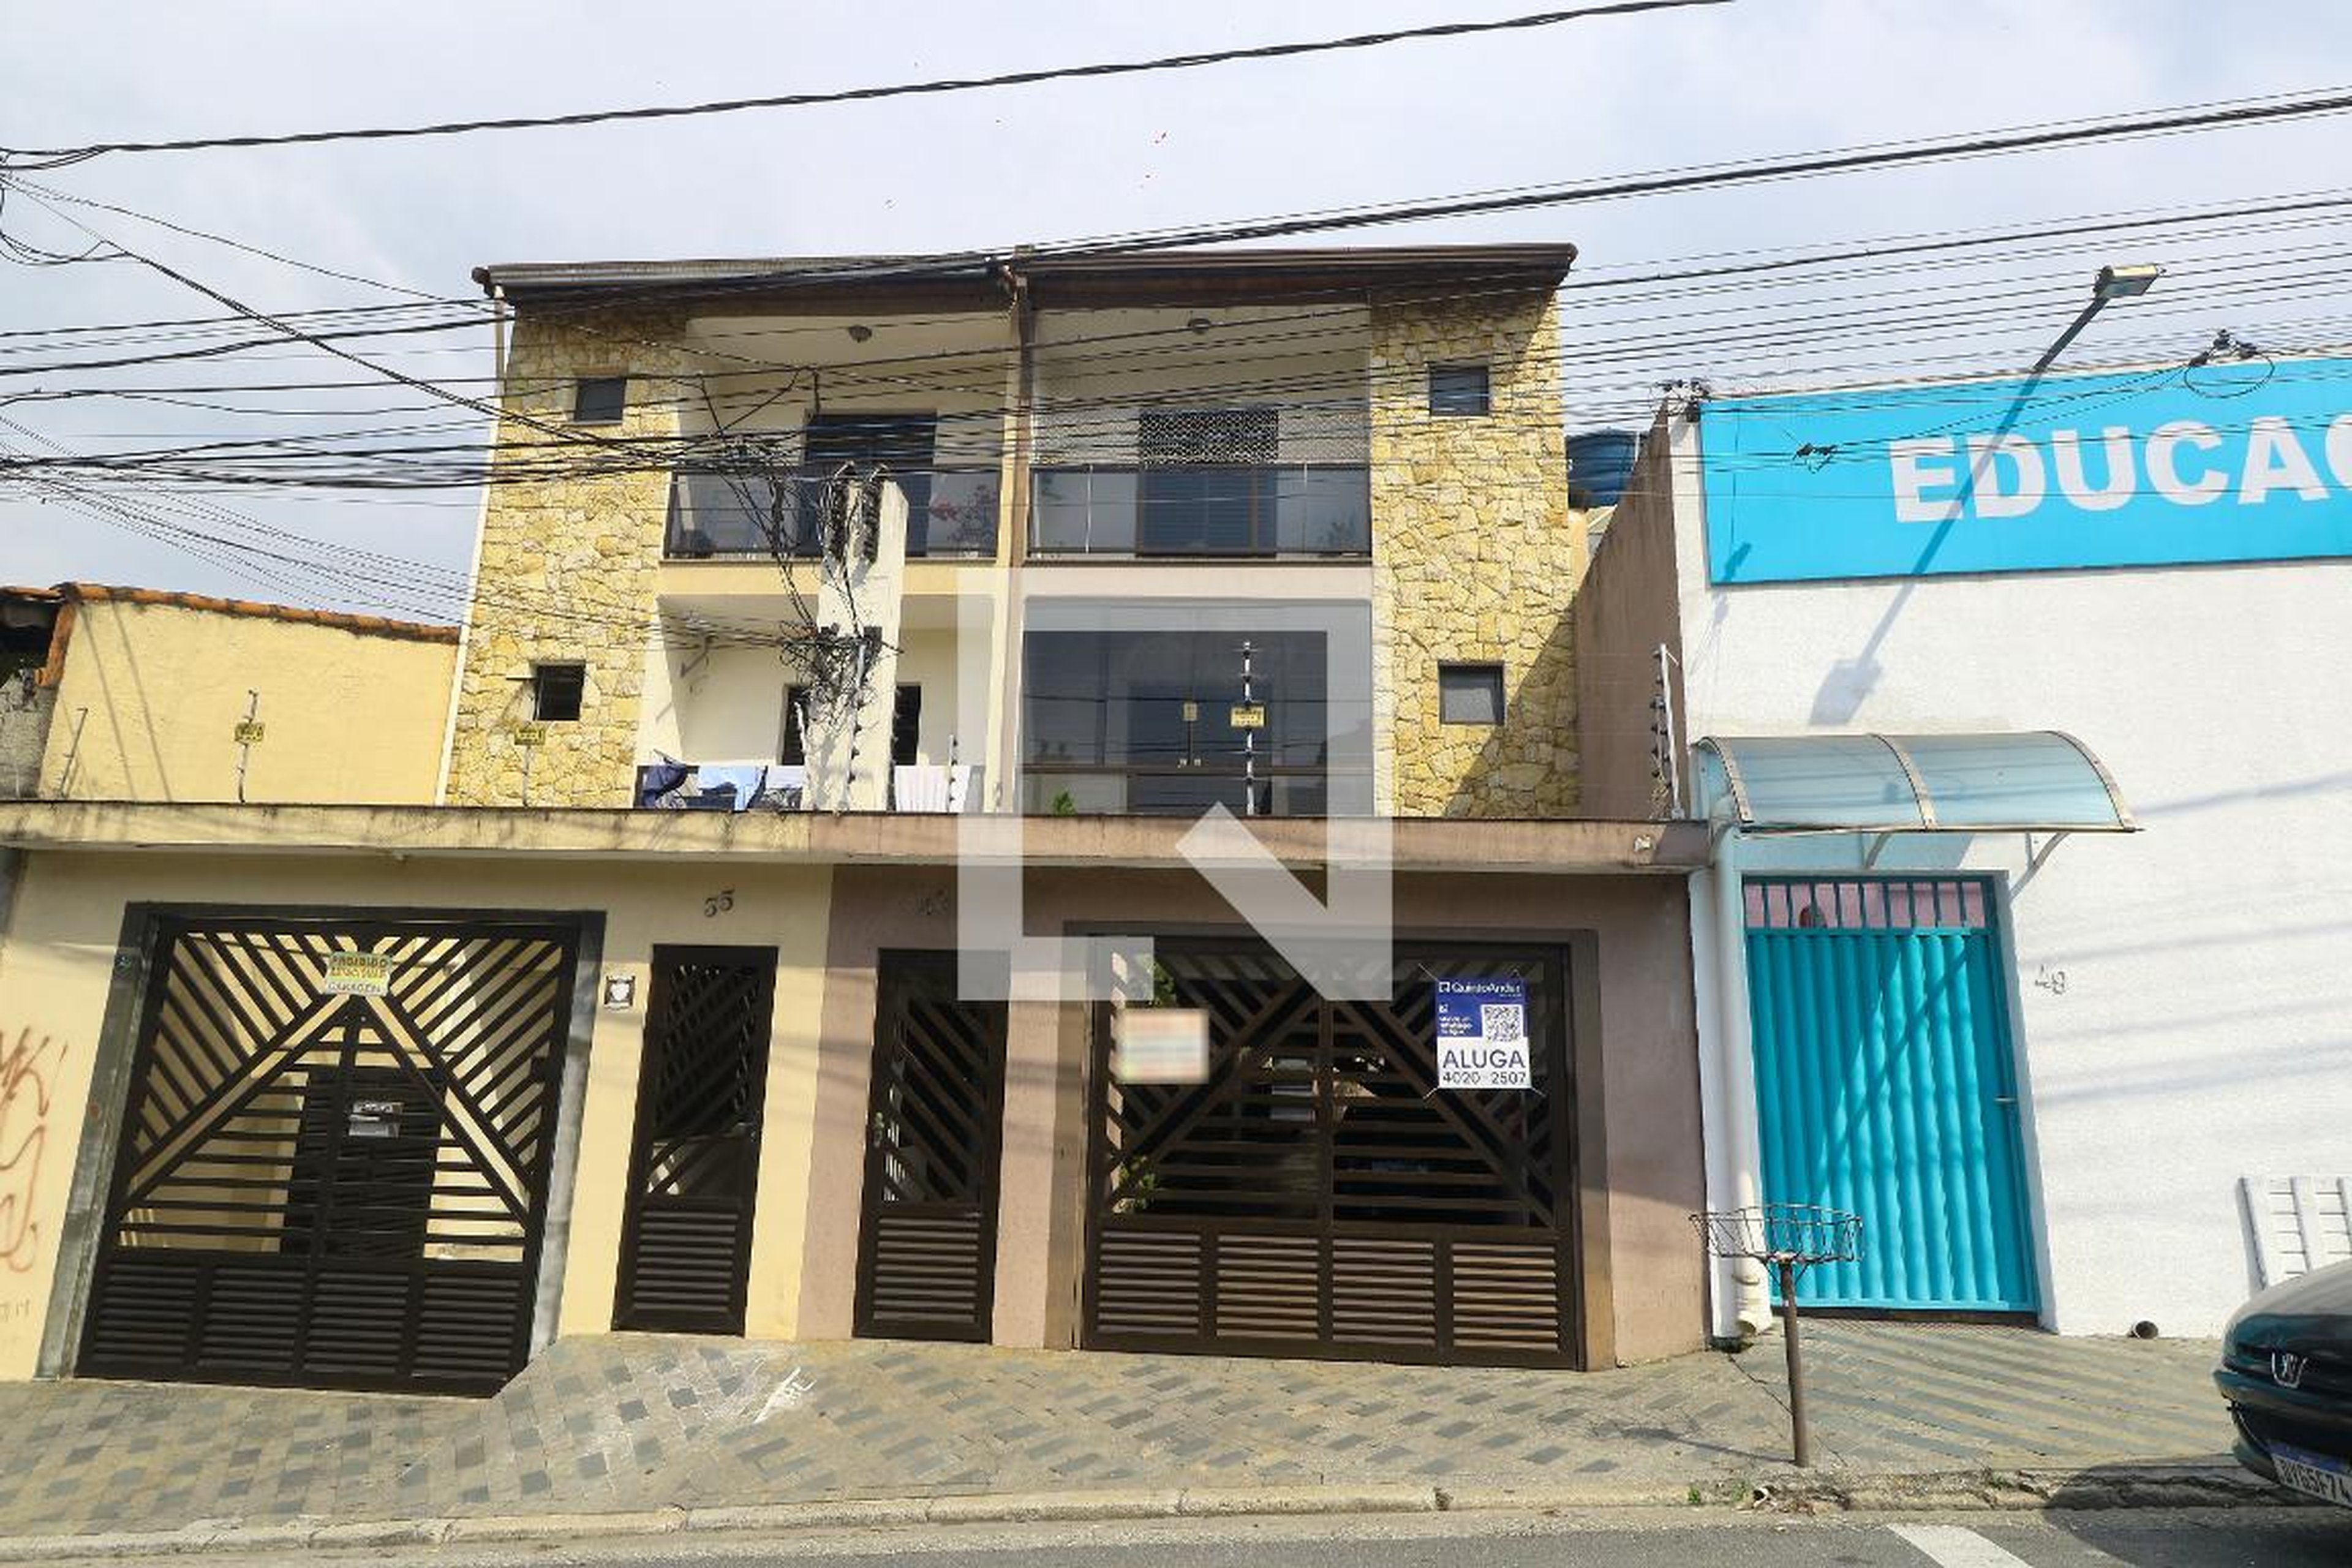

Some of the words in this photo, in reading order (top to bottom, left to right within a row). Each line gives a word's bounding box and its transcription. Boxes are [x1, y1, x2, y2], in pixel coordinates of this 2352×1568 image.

[1442, 1049, 1526, 1068] ALUGA
[1442, 1071, 1481, 1085] 4020
[1491, 1071, 1526, 1085] 2507
